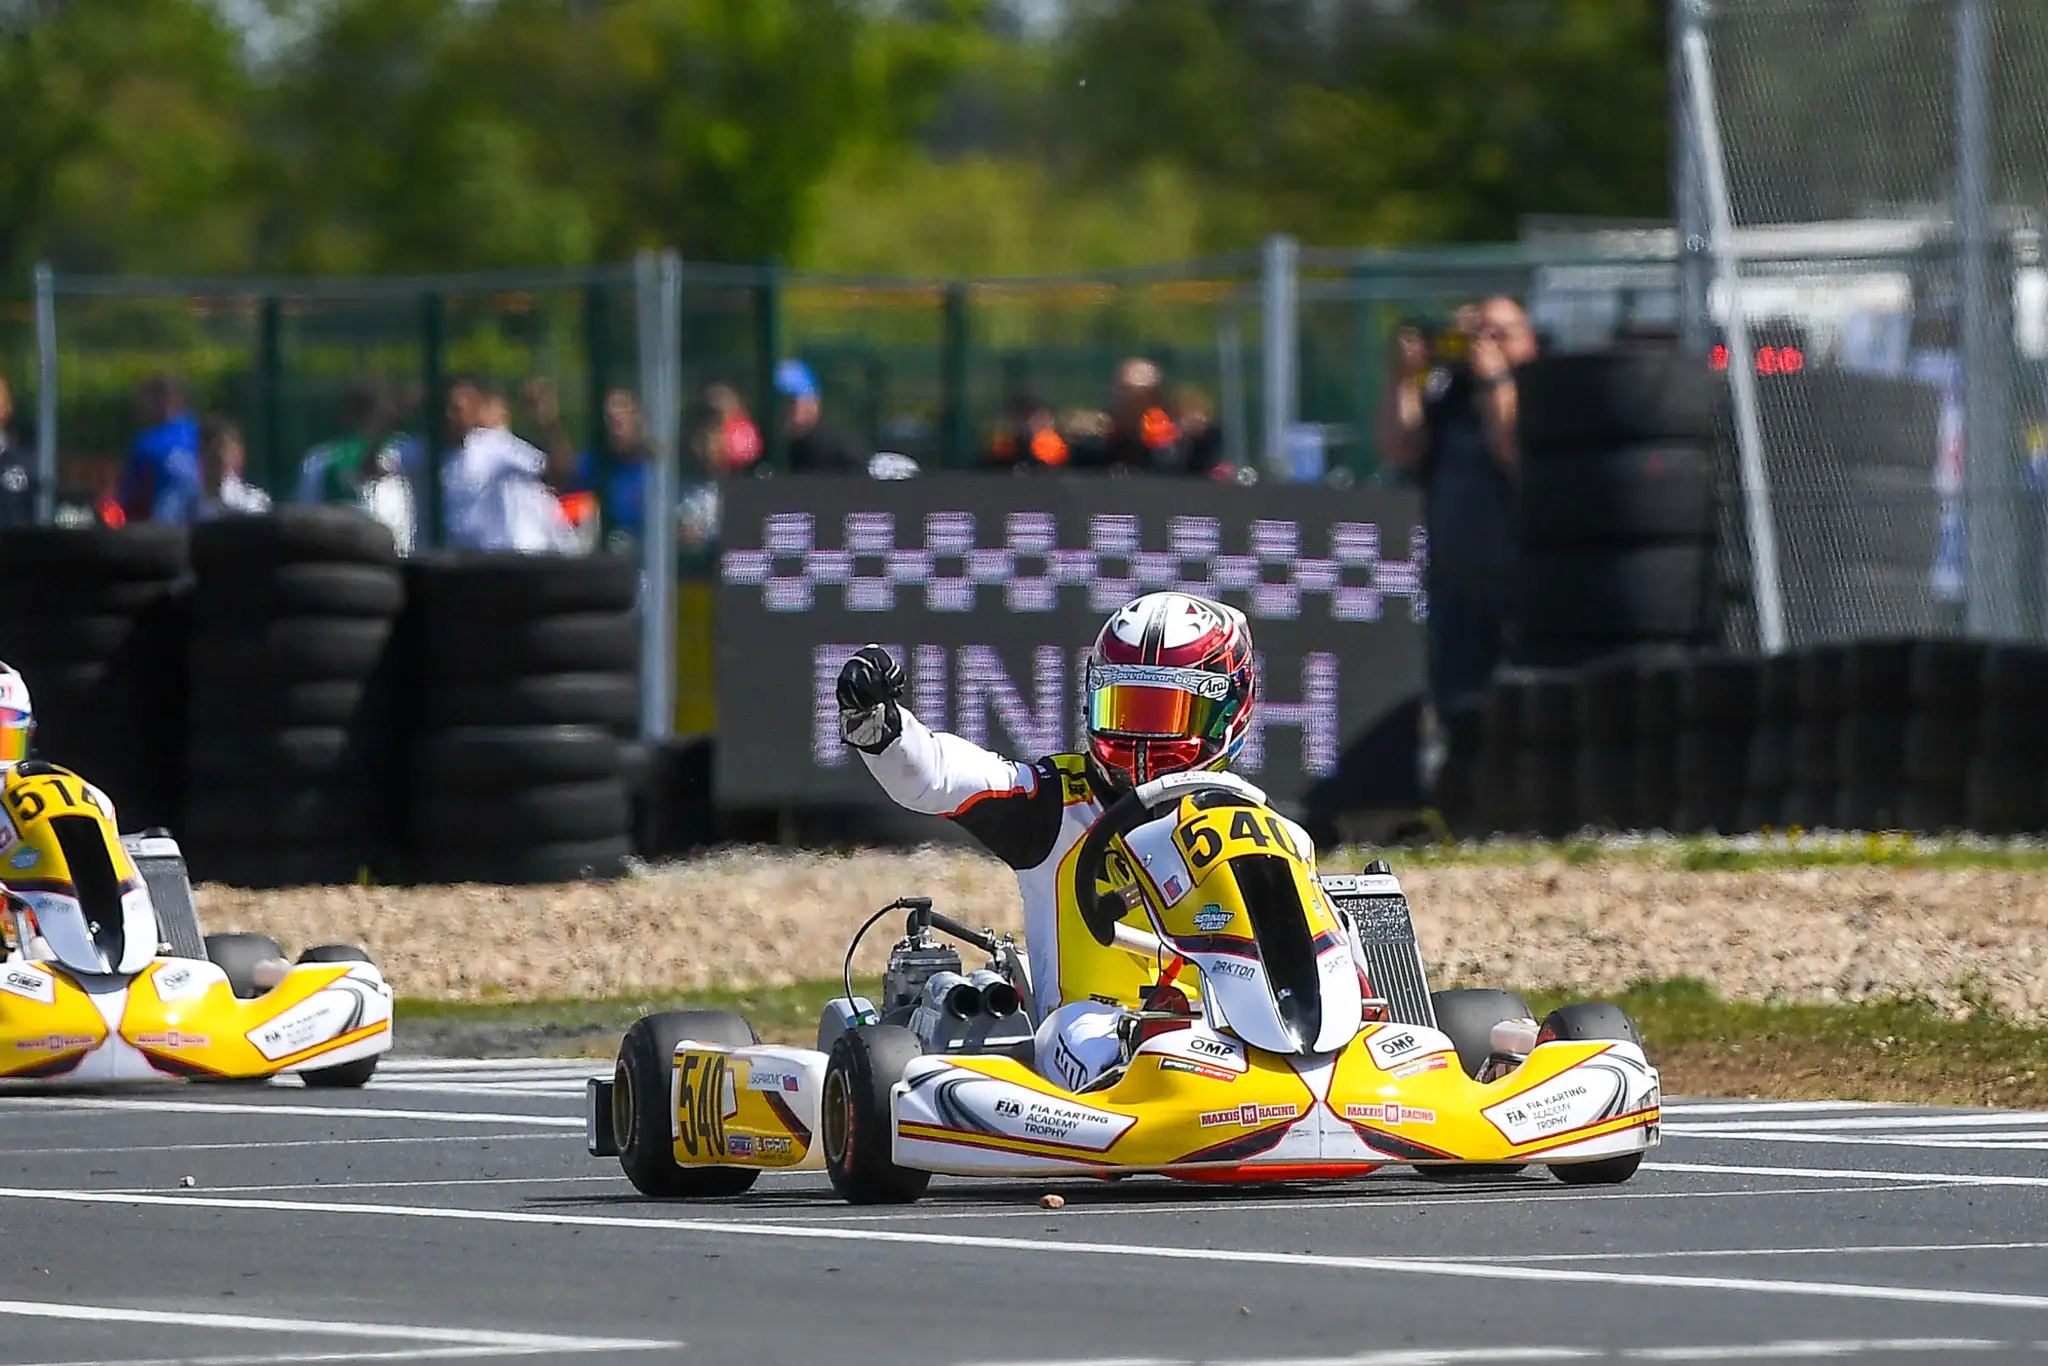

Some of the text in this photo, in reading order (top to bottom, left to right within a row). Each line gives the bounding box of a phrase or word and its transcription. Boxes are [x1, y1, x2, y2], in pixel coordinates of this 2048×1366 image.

[812, 643, 1338, 778] FINH
[1180, 810, 1302, 868] 540
[1190, 1040, 1234, 1056] OMP
[1381, 1035, 1415, 1054] OMP
[680, 1055, 725, 1156] 540
[1526, 1086, 1587, 1110] FIA KARTING
[994, 1099, 1022, 1117] FIA
[1030, 1103, 1109, 1124] FIA KARTING
[1201, 1110, 1240, 1125] MAXXIS
[1259, 1105, 1295, 1118] RACING
[1347, 1106, 1383, 1117] MAXXIS
[1401, 1109, 1434, 1121] RACING
[1506, 1109, 1527, 1124] FIA
[1026, 1113, 1080, 1129] ACADEMY
[1536, 1115, 1568, 1131] TROPHY
[1025, 1123, 1068, 1138] TROPHY
